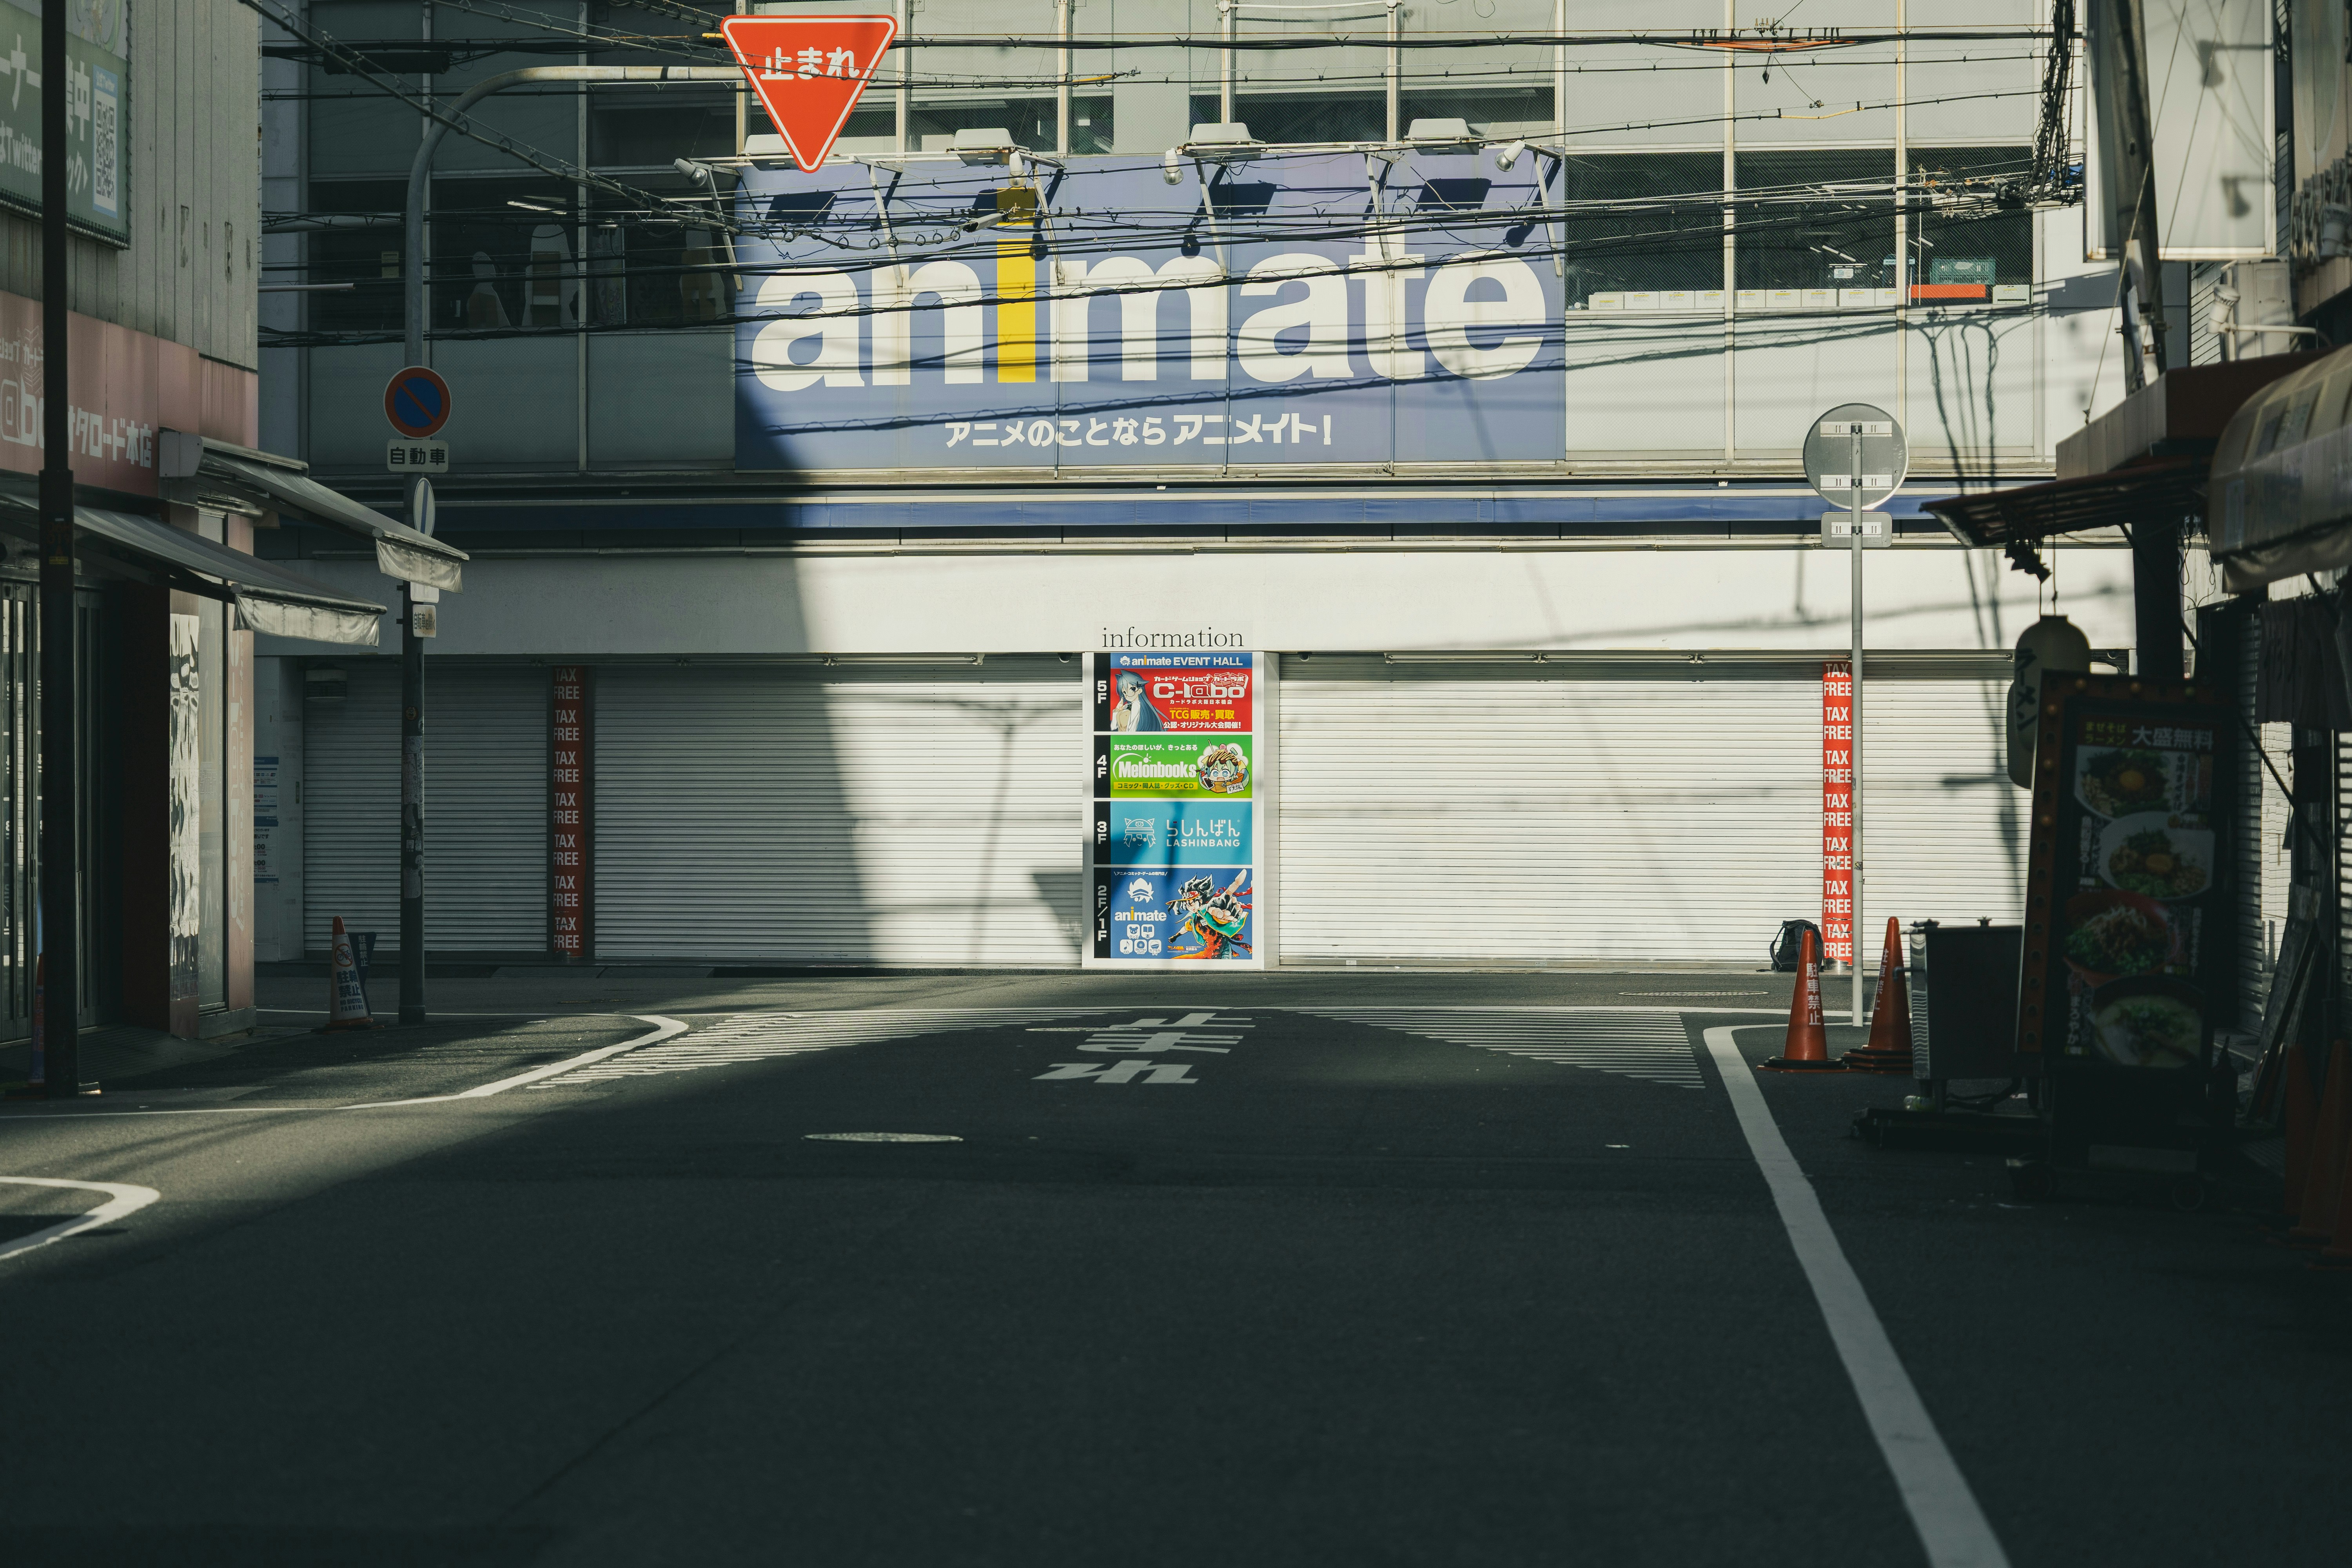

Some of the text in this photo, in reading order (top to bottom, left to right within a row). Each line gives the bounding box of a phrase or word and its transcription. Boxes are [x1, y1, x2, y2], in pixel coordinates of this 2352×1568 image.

[760, 46, 860, 80] 止まれ
[750, 188, 1546, 392] animate
[945, 417, 1166, 448] アニメのことなら
[390, 446, 445, 465] 自動車
[414, 612, 436, 631] 自転車を除く
[1102, 626, 1244, 648] information
[1132, 655, 1243, 666] animate EVENT HALL
[555, 668, 577, 681] TAX
[1826, 664, 1849, 677] TAX
[553, 686, 580, 699] FREE
[1097, 680, 1107, 704] 5F
[1824, 682, 1852, 696] FREE
[2016, 648, 2037, 732] ラーメン
[555, 710, 576, 723] TAX
[1170, 710, 1235, 720] TCG 販売・買取
[1825, 707, 1849, 721] TAX
[1824, 726, 1852, 740] FREE
[2085, 721, 2127, 733] まぜそば
[554, 728, 579, 741] FREE
[2085, 733, 2127, 746] ラーメン
[2131, 725, 2214, 752] 大盛無料
[555, 751, 576, 764] TAX
[1825, 750, 1849, 764] TAX
[1096, 755, 1107, 778] 4F
[1118, 761, 1196, 779] Melonbooks
[553, 769, 579, 782] FREE
[1824, 769, 1851, 783] FREE
[554, 793, 576, 806] TAX
[1825, 793, 1849, 808] TAX
[553, 811, 579, 824] FREE
[1824, 812, 1852, 826] FREE
[1096, 821, 1107, 844] 3F
[1166, 819, 1240, 837] らしんばん
[554, 834, 575, 848] TAX
[1166, 839, 1240, 847] LASHINBANG
[1825, 837, 1848, 851] TAX
[553, 852, 579, 865] FREE
[1824, 856, 1851, 870] FREE
[554, 876, 575, 889] TAX
[1825, 880, 1848, 895] TAX
[553, 893, 579, 907] FREE
[1824, 899, 1851, 913] FREE
[1114, 906, 1167, 922] animate
[555, 917, 576, 930] TAX
[1826, 924, 1849, 938] TAX
[554, 935, 579, 948] FREE
[358, 935, 368, 967] 駐輪禁止
[1824, 942, 1852, 957] FREE
[336, 969, 358, 985] 駐輪
[338, 984, 361, 998] 禁止
[1806, 962, 1821, 1025] 駐車禁止
[341, 1004, 364, 1013] PARKING
[1030, 1013, 1256, 1083] 止まれ
